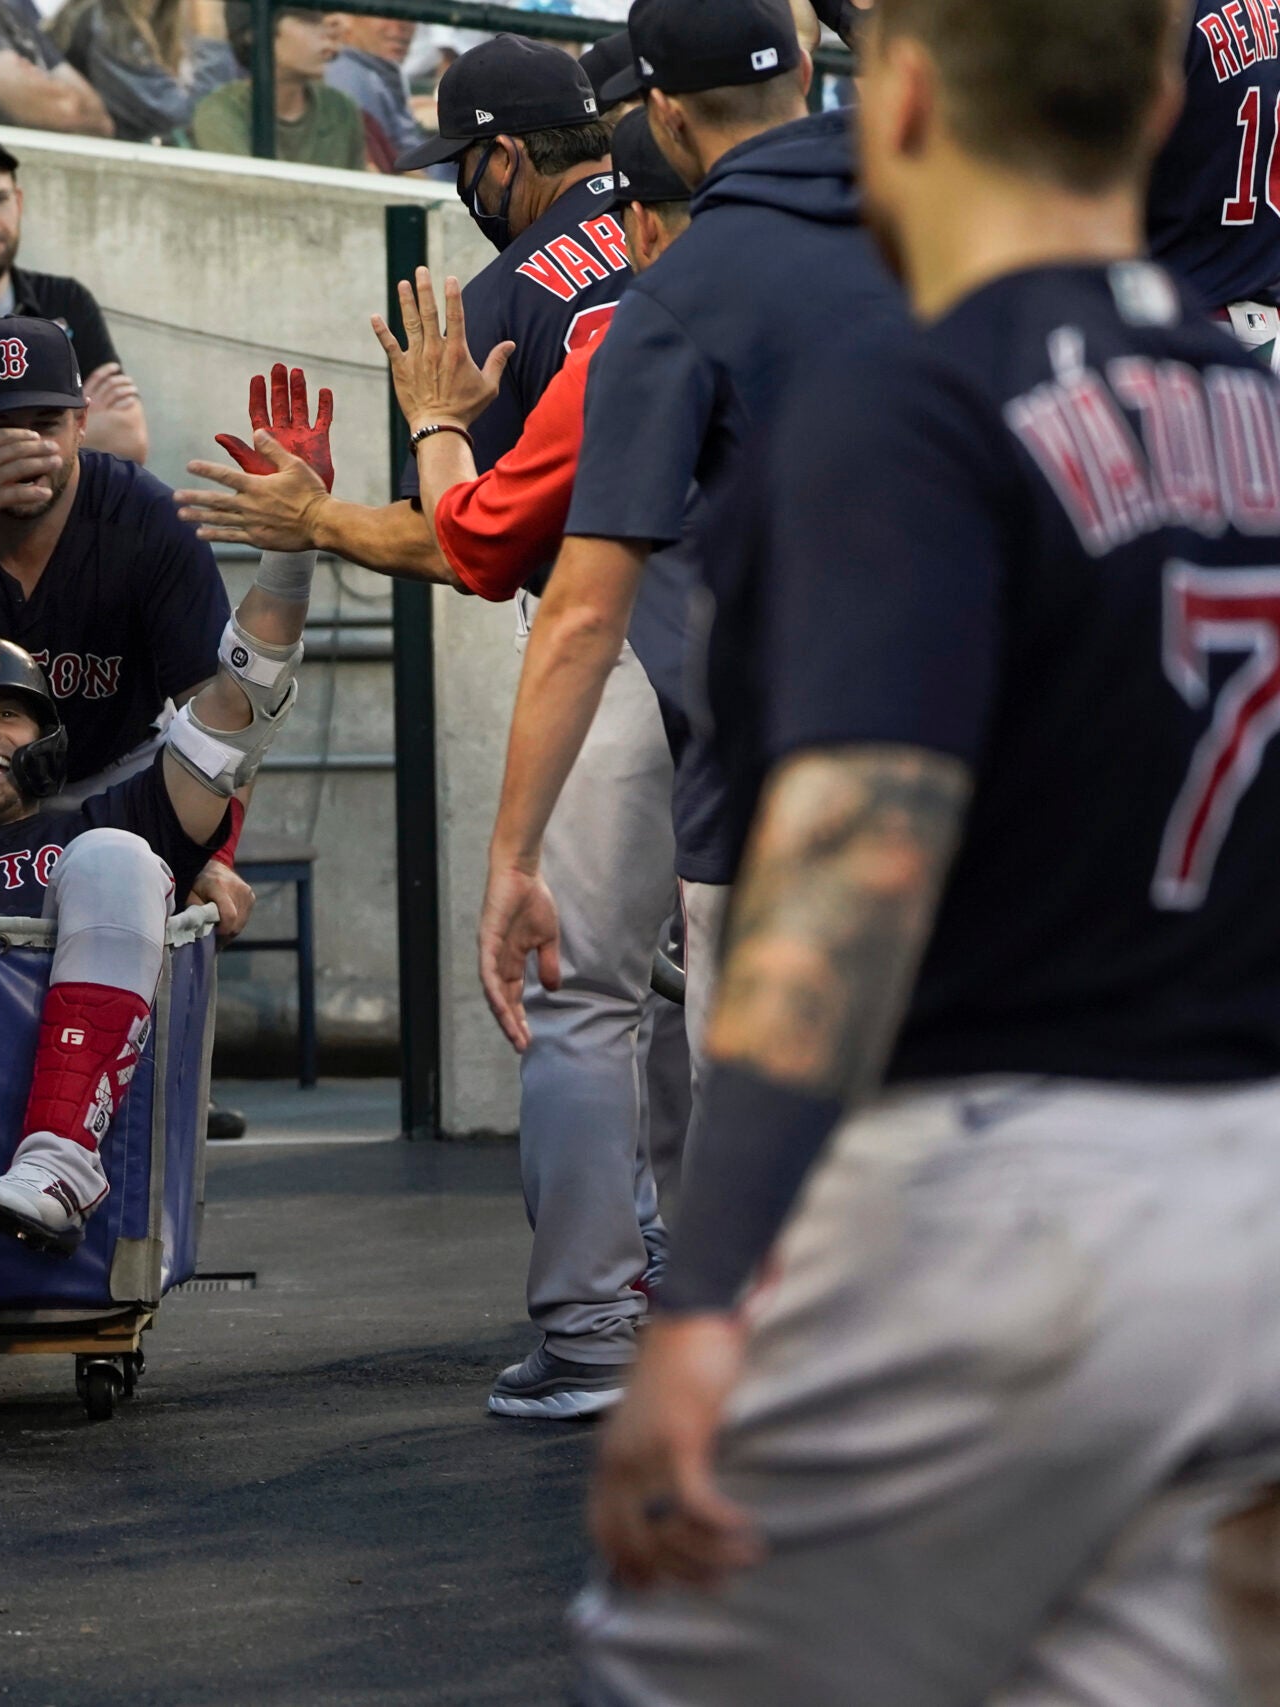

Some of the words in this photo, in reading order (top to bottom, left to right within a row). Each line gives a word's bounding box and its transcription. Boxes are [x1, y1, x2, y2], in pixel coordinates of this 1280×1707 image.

[1196, 0, 1280, 83] RENF
[1221, 86, 1280, 226] 1
[1149, 557, 1280, 912] 7
